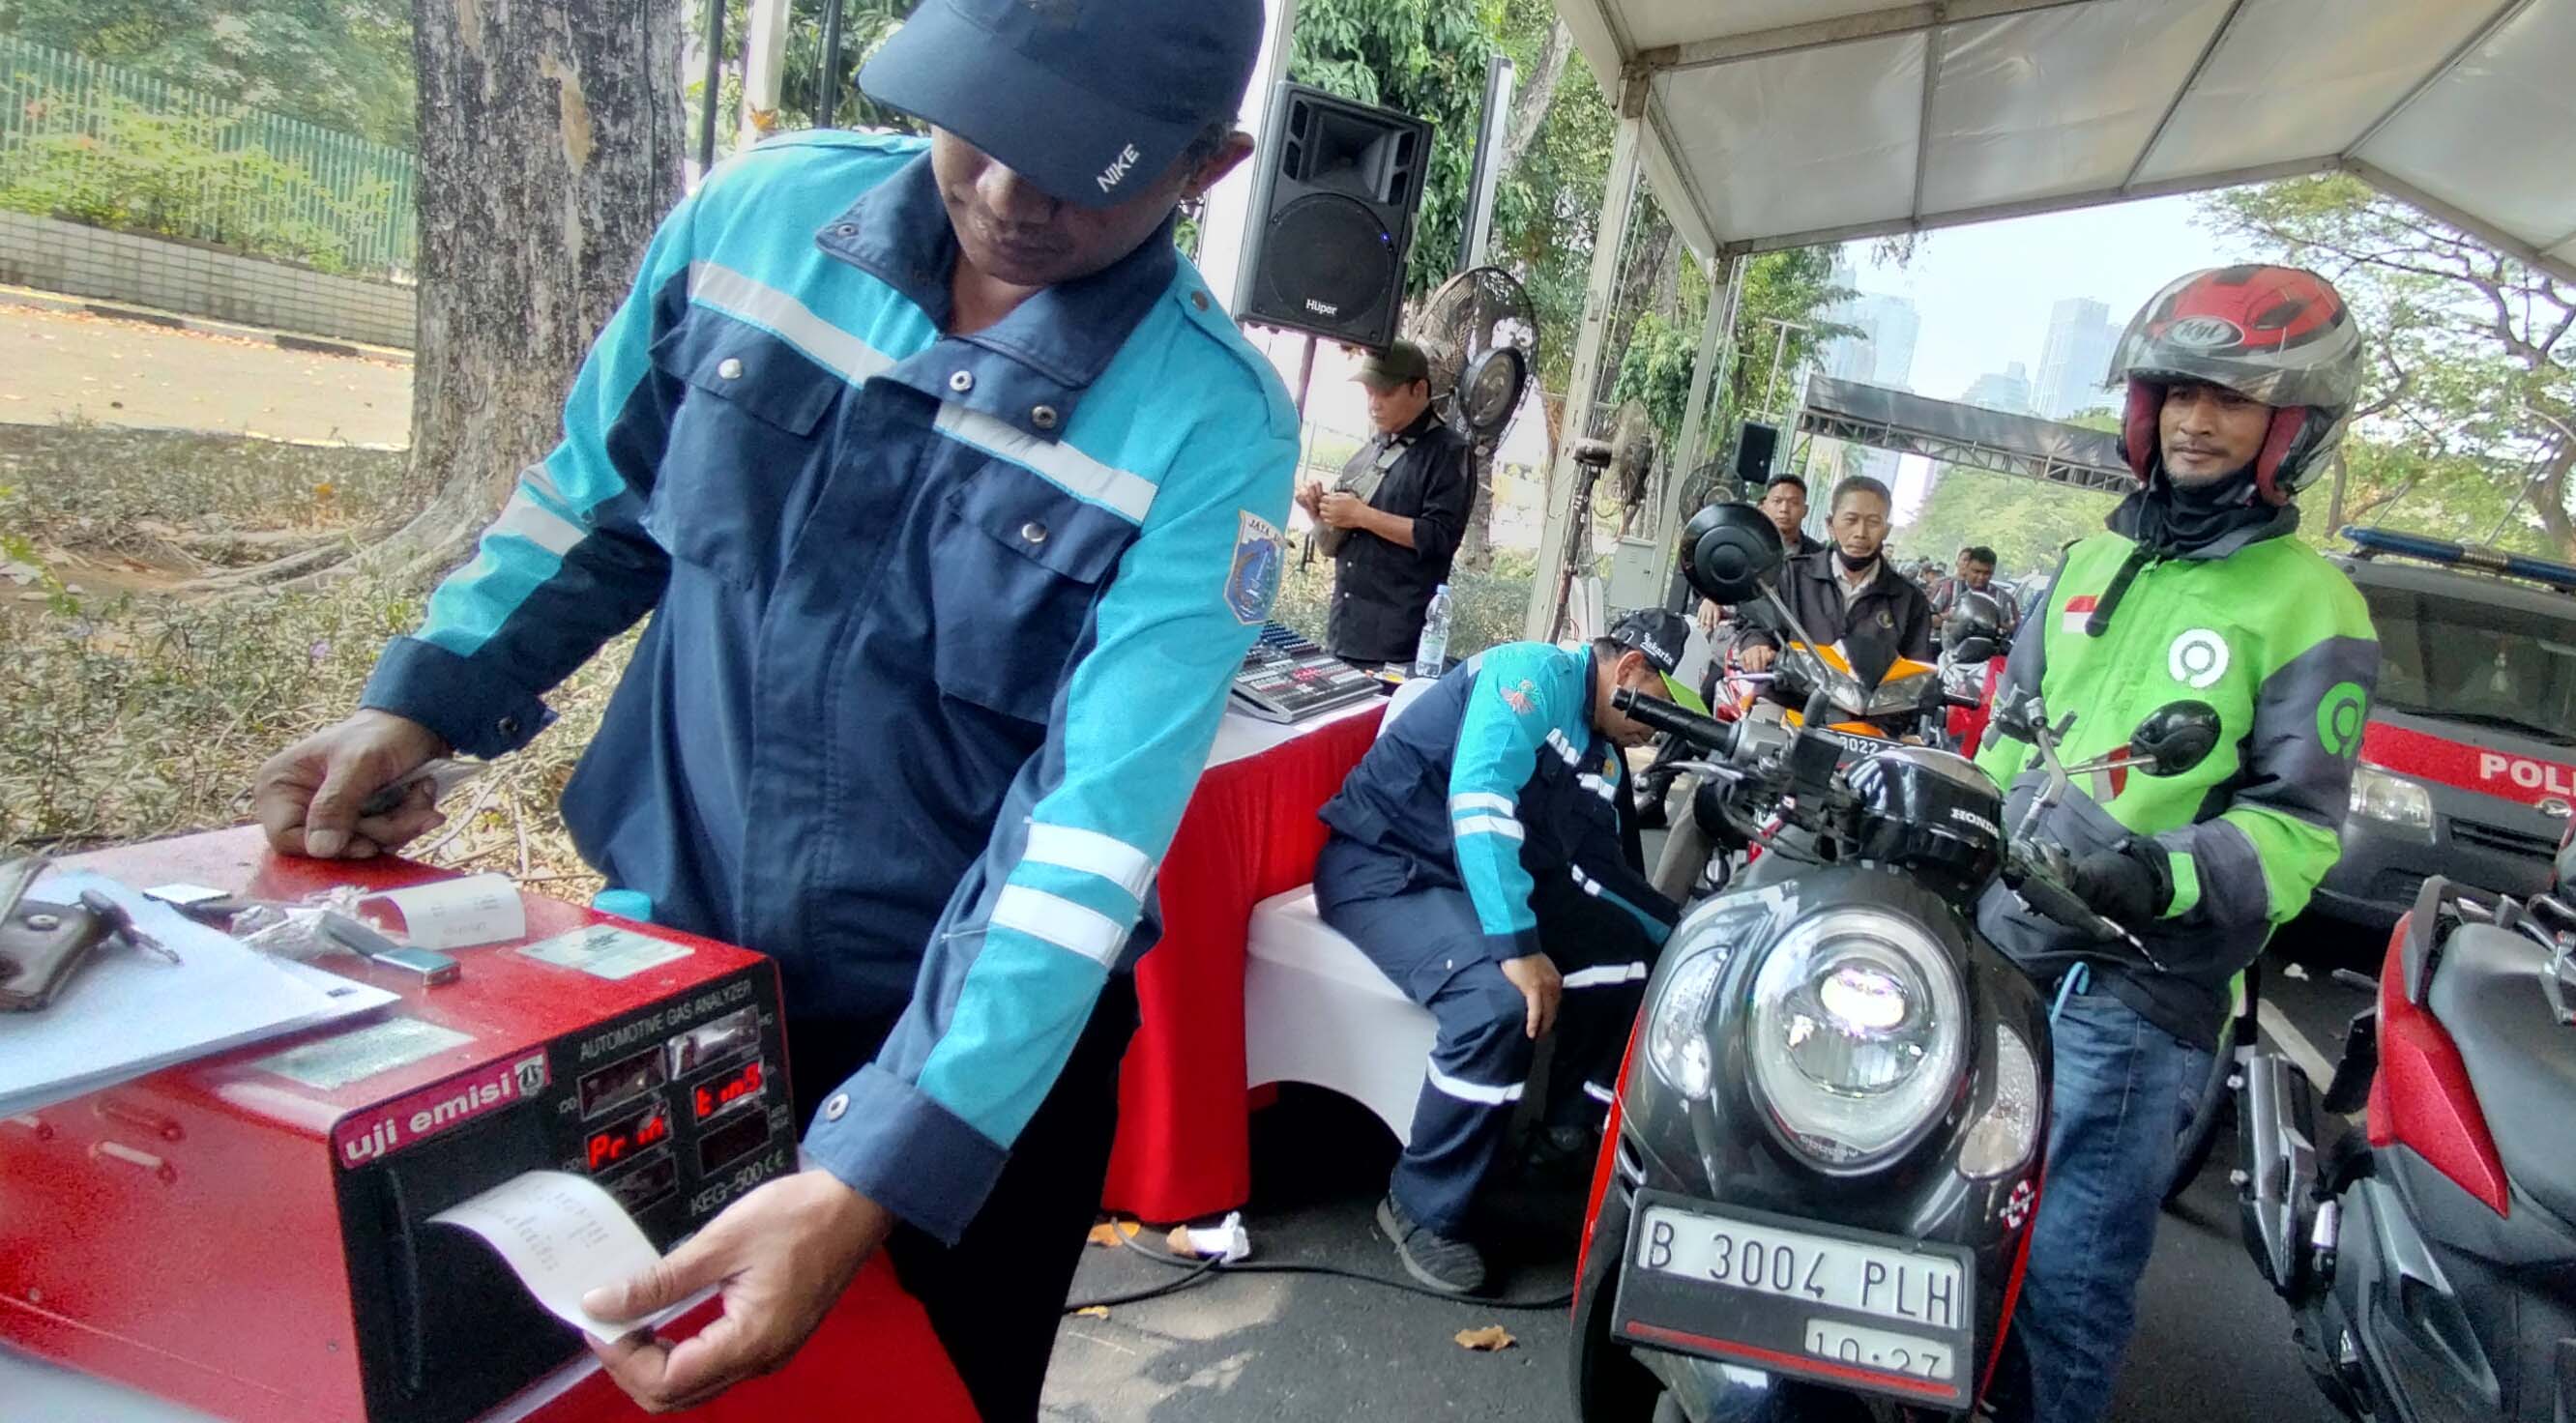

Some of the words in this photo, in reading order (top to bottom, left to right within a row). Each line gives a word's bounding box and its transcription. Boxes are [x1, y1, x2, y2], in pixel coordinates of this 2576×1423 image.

[1096, 143, 1140, 193] NIKE
[1639, 634, 1674, 666] Jakarta
[1949, 808, 2000, 841] HONDA
[580, 1013, 665, 1060] AUTOMOTIVE
[666, 1002, 693, 1027] GAS
[694, 978, 753, 1016] ANALYZER
[345, 1118, 397, 1160] uji
[409, 1072, 512, 1134] emisi
[689, 1162, 764, 1216] KEG-500
[1648, 1220, 1675, 1268] B
[1709, 1233, 1826, 1299] 3004
[1861, 1260, 1952, 1325] PLH
